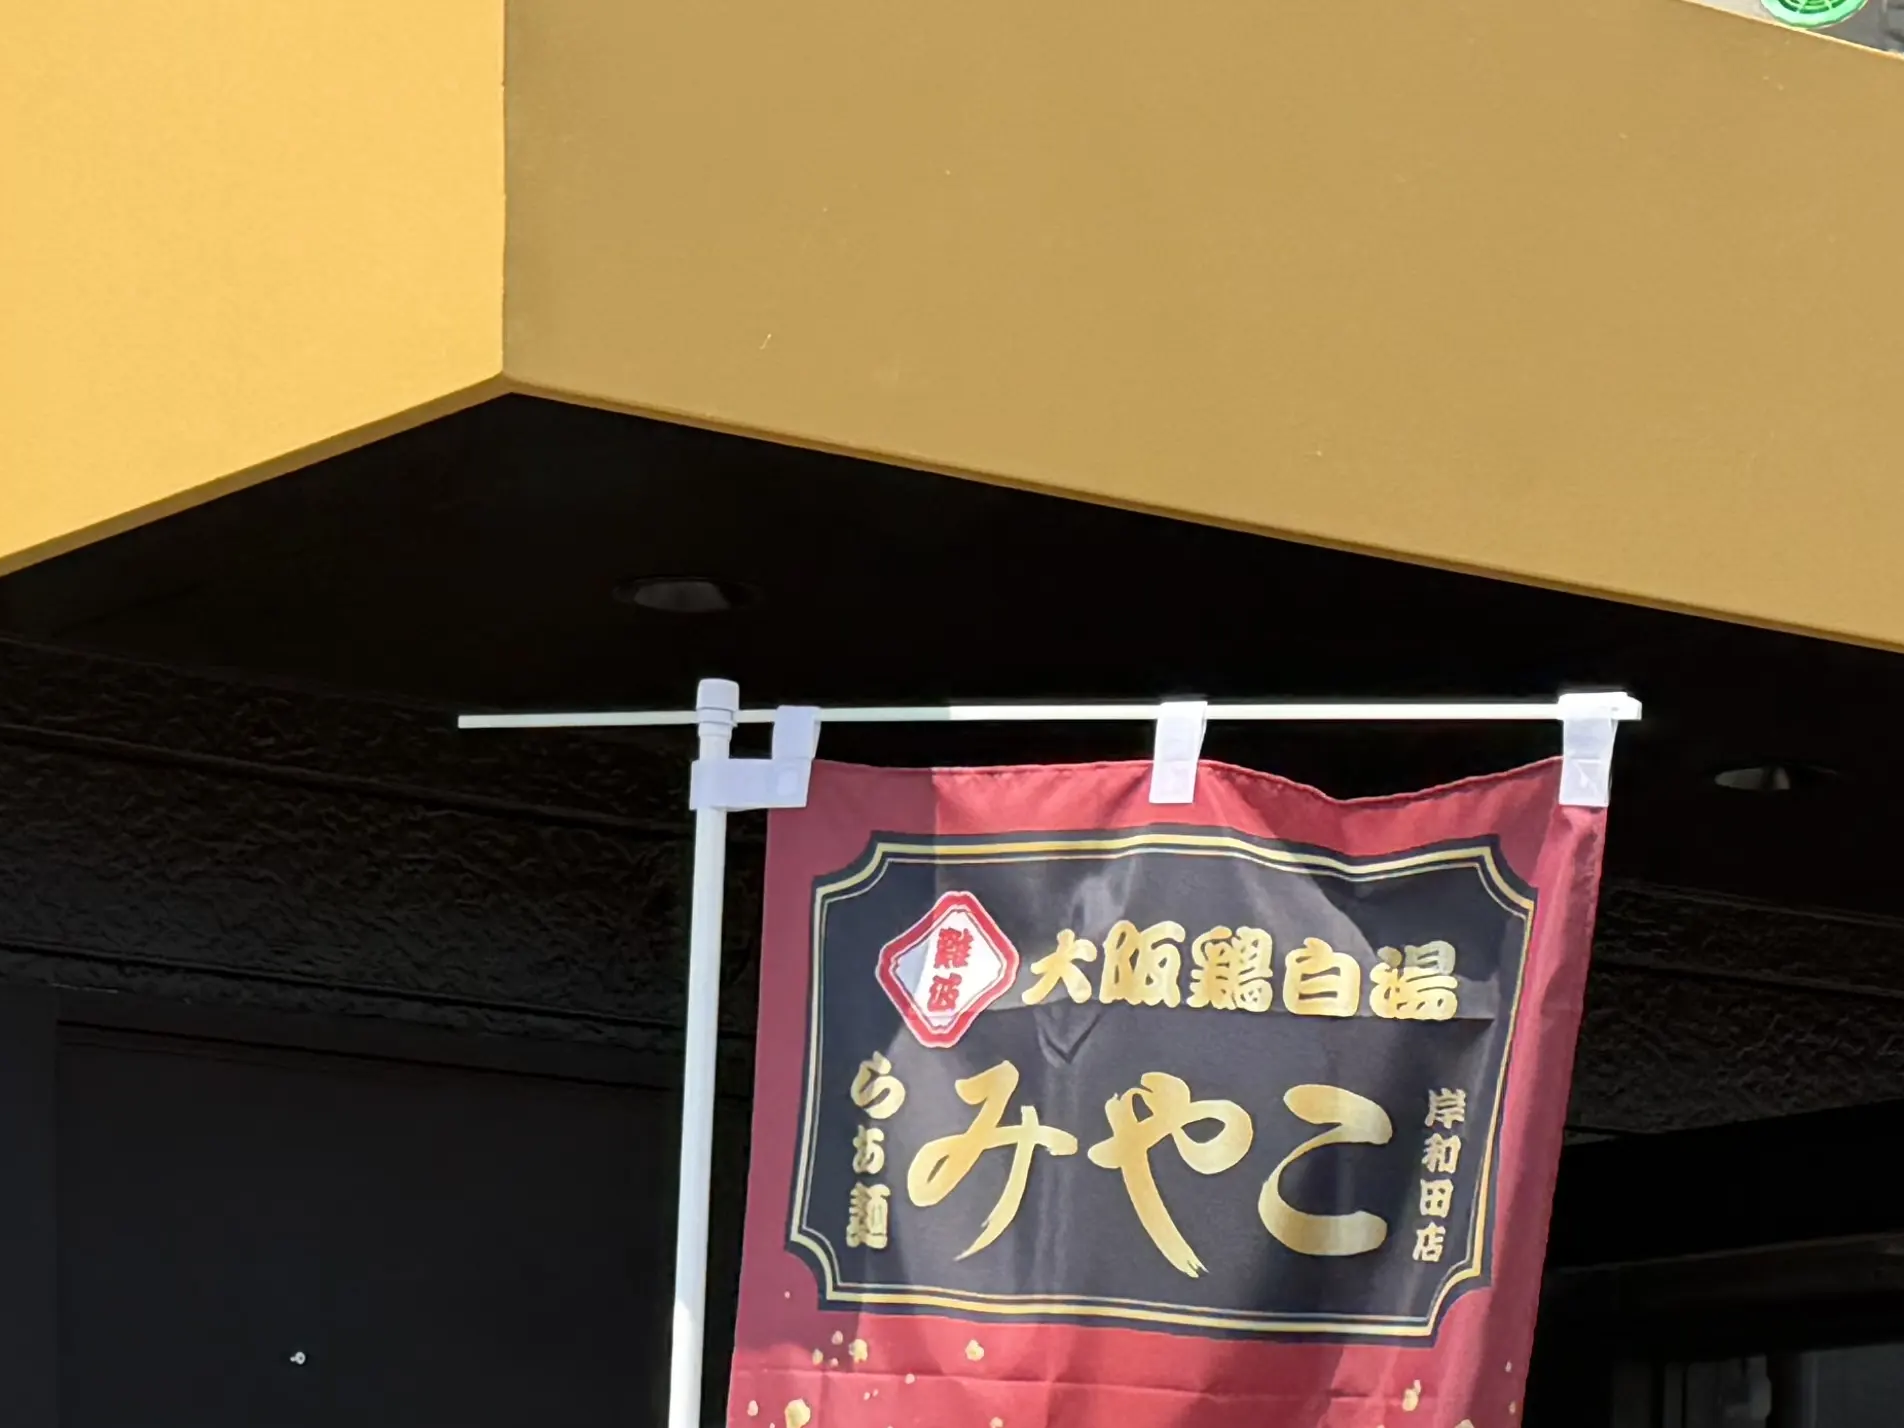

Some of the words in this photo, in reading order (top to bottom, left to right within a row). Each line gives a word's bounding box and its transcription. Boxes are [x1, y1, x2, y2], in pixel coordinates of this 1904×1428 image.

[1021, 919, 1458, 1022] 大阪鶏白湯
[846, 1050, 907, 1250] らぁ麺
[905, 1058, 1393, 1278] みやこ
[1412, 1086, 1468, 1263] 岸和田店
